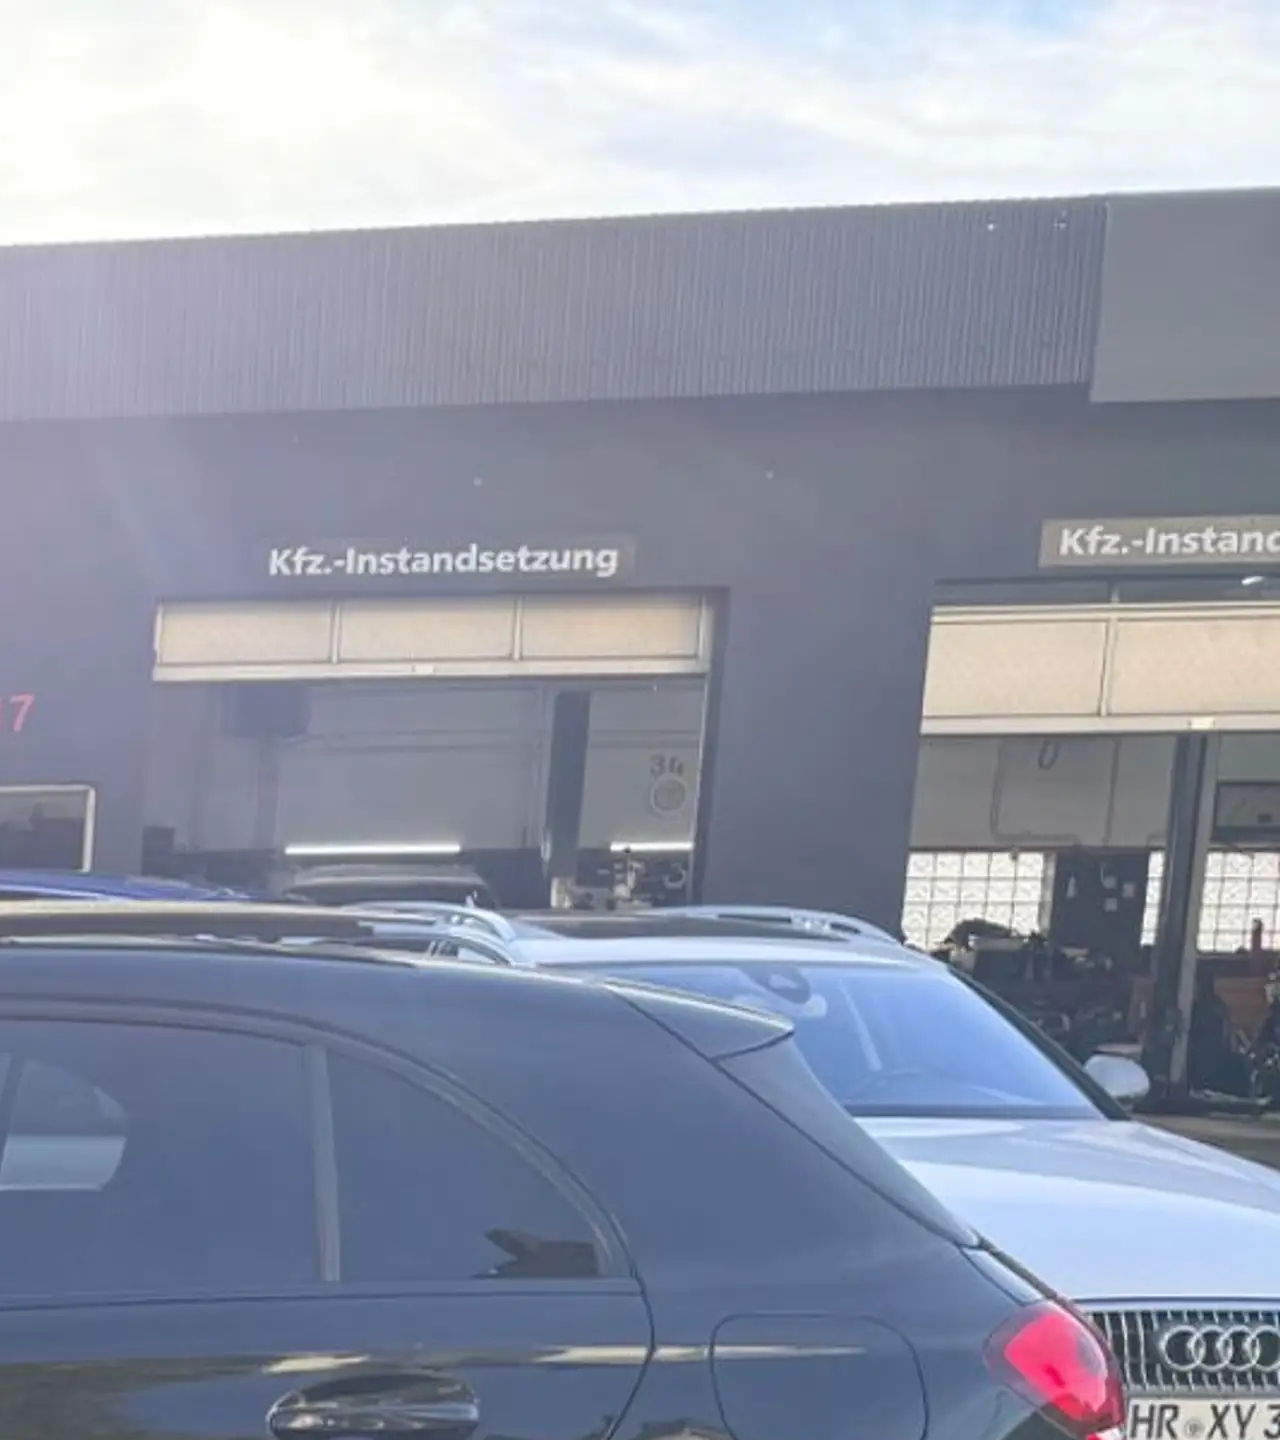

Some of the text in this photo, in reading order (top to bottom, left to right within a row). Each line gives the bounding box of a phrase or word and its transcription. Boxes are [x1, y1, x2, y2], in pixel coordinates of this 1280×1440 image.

[268, 543, 619, 578] Kfz.-Instandsetzung
[1130, 1404, 1180, 1440] HR
[1206, 1404, 1257, 1440] XY
